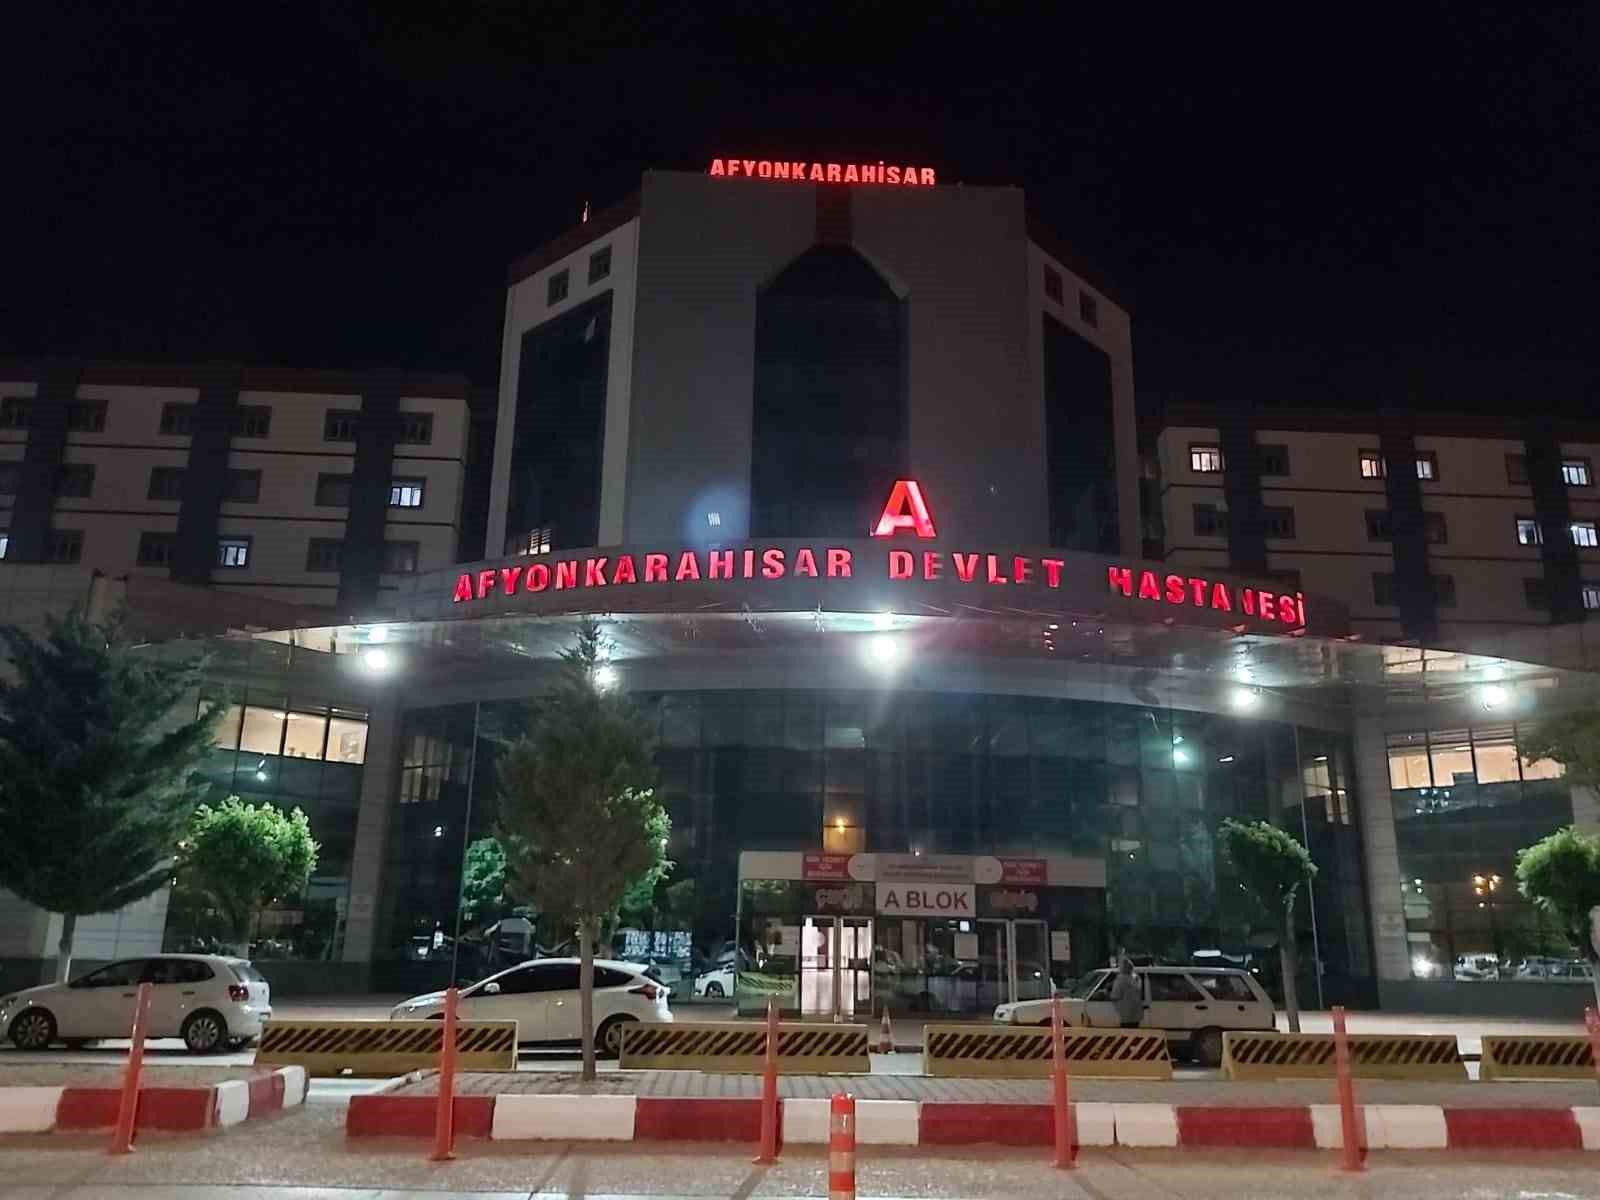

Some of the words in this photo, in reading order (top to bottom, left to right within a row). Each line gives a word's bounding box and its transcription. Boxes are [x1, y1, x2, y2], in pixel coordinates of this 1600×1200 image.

[871, 480, 936, 538] A
[453, 549, 854, 602] AFYONKARAHISAR
[888, 550, 1065, 588] DEVLET
[884, 891, 899, 909] A
[907, 891, 969, 911] BLOK
